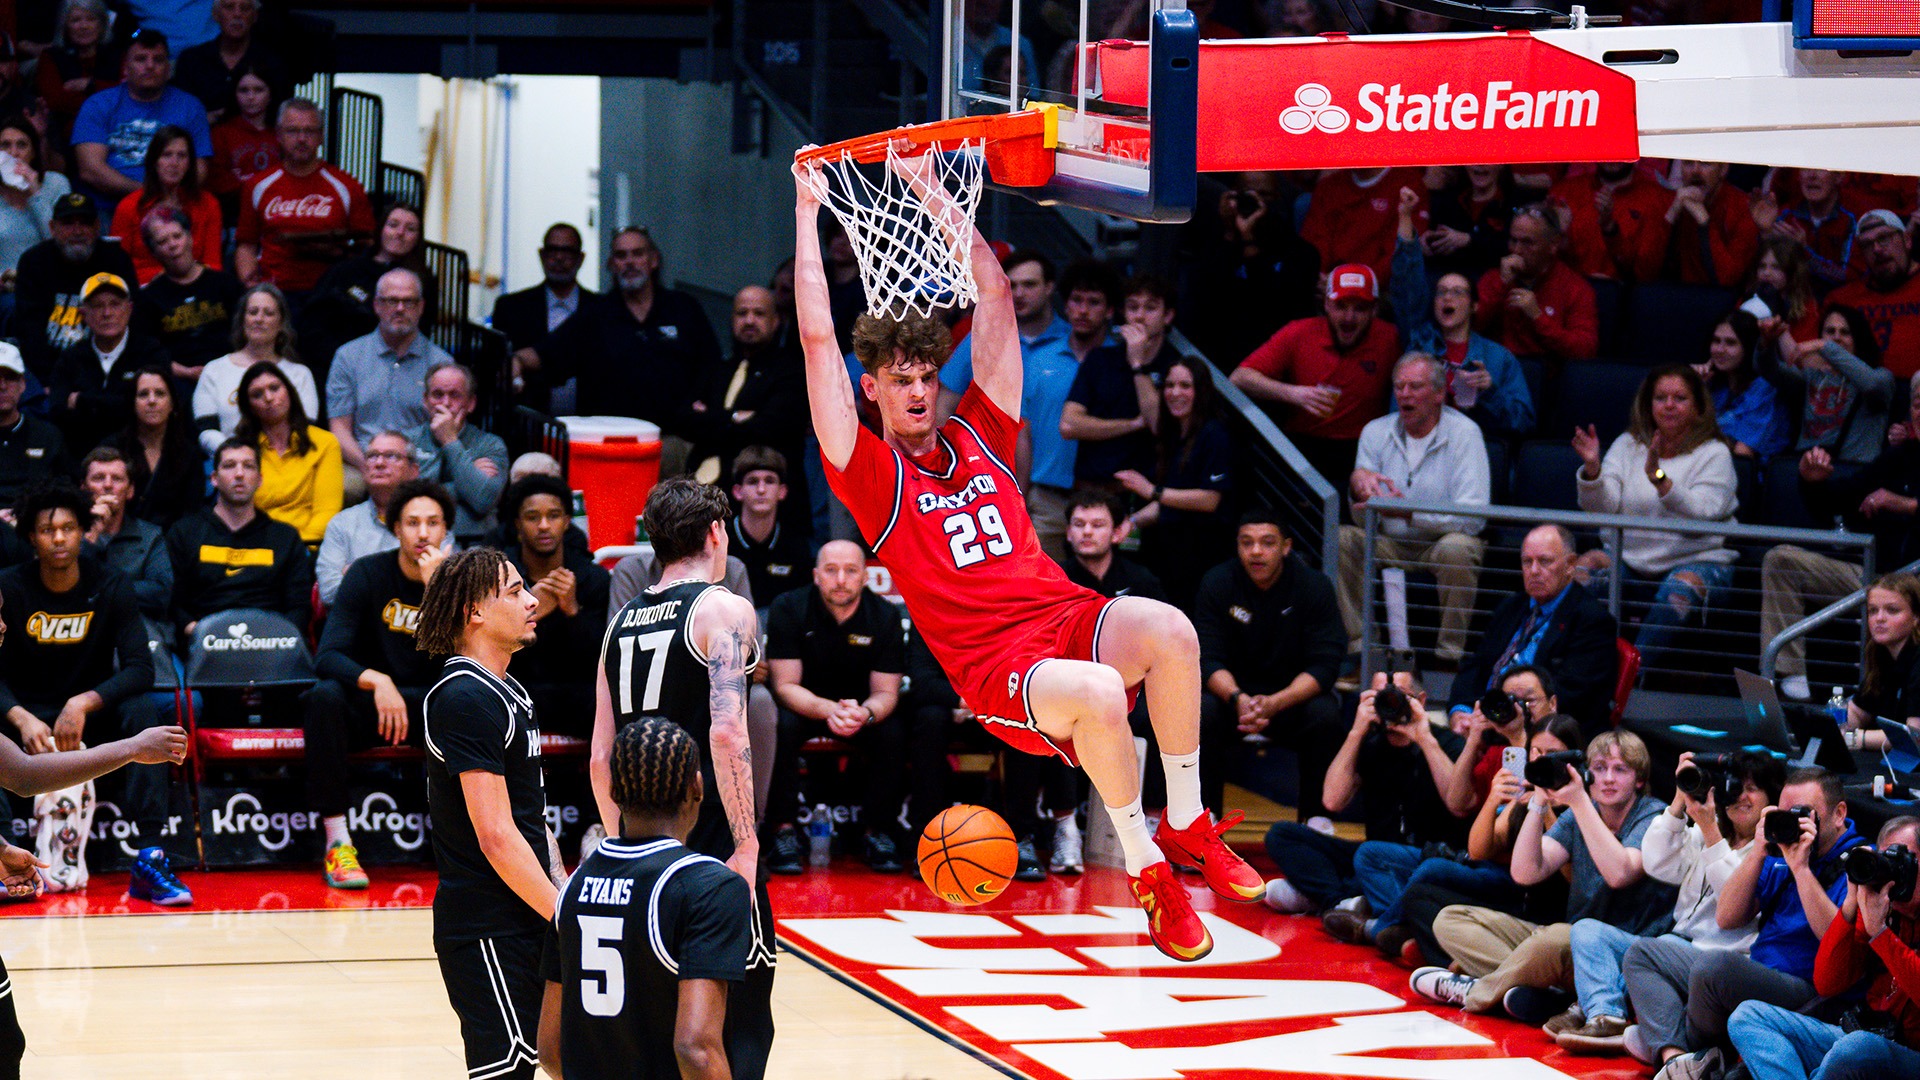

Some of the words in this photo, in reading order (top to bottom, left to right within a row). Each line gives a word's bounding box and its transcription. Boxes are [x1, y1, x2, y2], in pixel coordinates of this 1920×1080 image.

[1356, 82, 1479, 133] State
[1482, 80, 1600, 129] Farm
[917, 474, 998, 514] DAYTON
[942, 504, 1013, 570] 29
[36, 612, 92, 641] VCU
[390, 601, 422, 631] VC
[621, 600, 683, 628] DJOKOVIC
[203, 634, 298, 651] CareSource
[618, 629, 676, 714] 17
[212, 792, 320, 851] Kroger
[578, 876, 635, 906] EVANS
[576, 914, 625, 1017] 5
